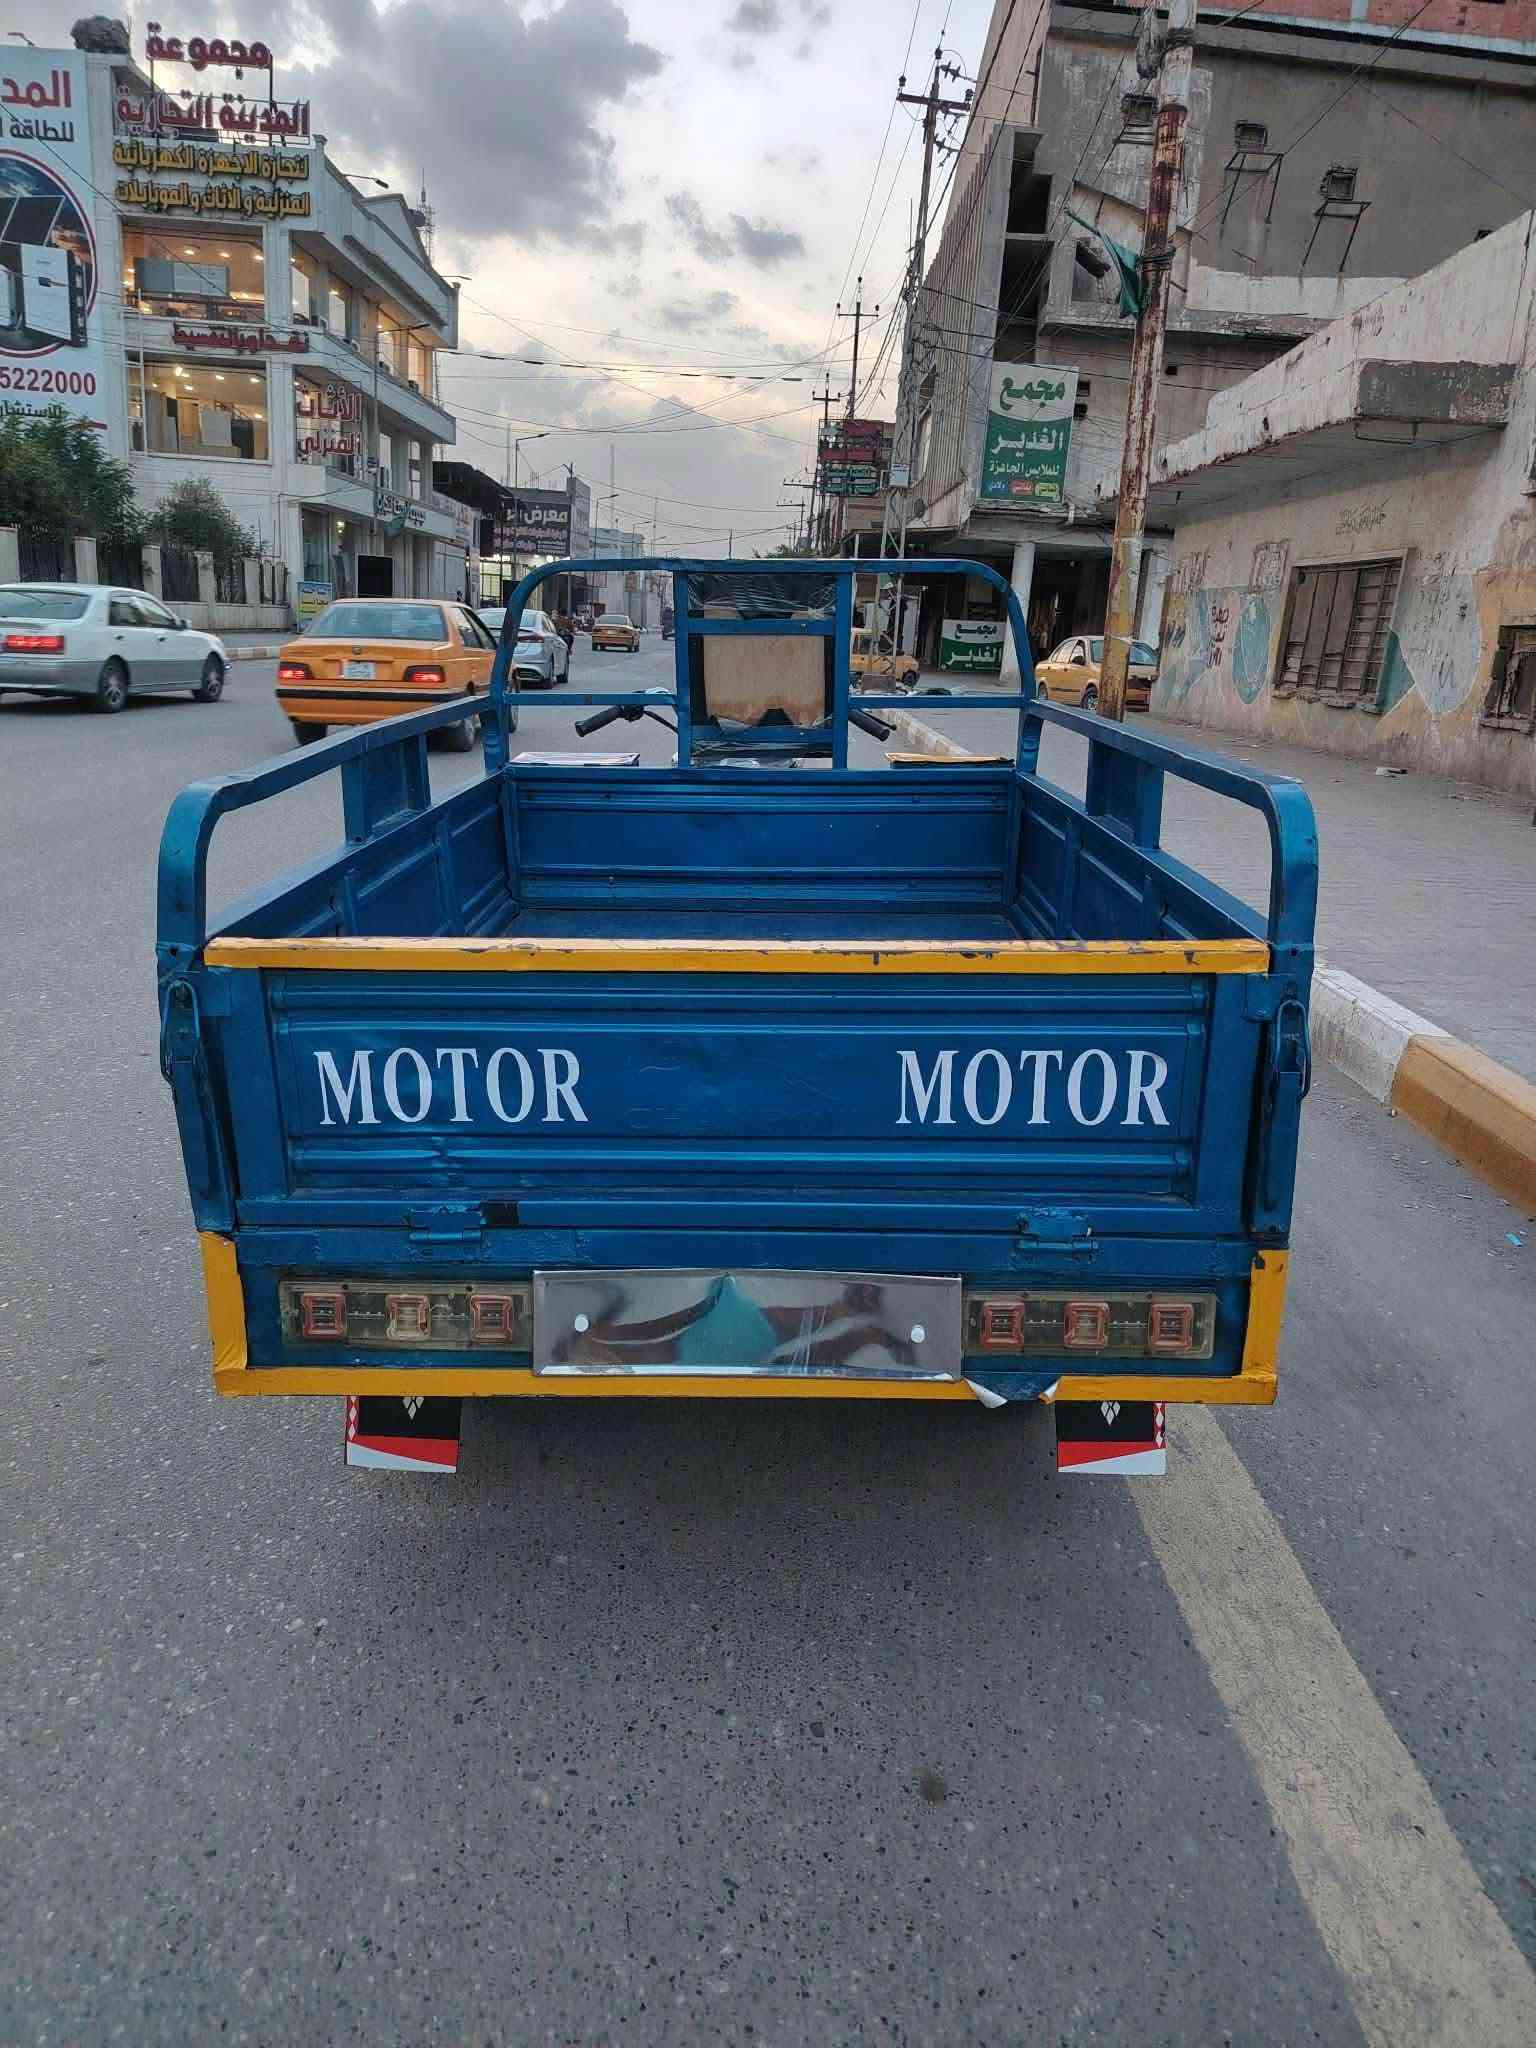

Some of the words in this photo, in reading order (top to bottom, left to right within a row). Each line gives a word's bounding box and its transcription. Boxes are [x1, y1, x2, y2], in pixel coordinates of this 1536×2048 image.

[145, 22, 272, 80] مجموعة
[0, 70, 71, 108] المد
[117, 82, 214, 137] التجارية
[219, 92, 310, 145] المدينة
[9, 119, 74, 143] للطاقة
[113, 138, 194, 176] الكهربائية
[261, 149, 309, 185] لتجارة
[190, 192, 200, 213] و
[243, 193, 255, 217] و
[0, 366, 97, 396] 5222000
[999, 377, 1066, 411] مجمع
[990, 427, 1064, 458] الغدير
[989, 460, 1025, 477] الجاهزة
[1024, 463, 1061, 479] للملابس
[524, 504, 568, 524] معرض
[954, 623, 998, 639] مجمع
[945, 645, 1002, 668] الغدير
[312, 1047, 590, 1124] MOTOR
[895, 1048, 1171, 1126] MOTOR
